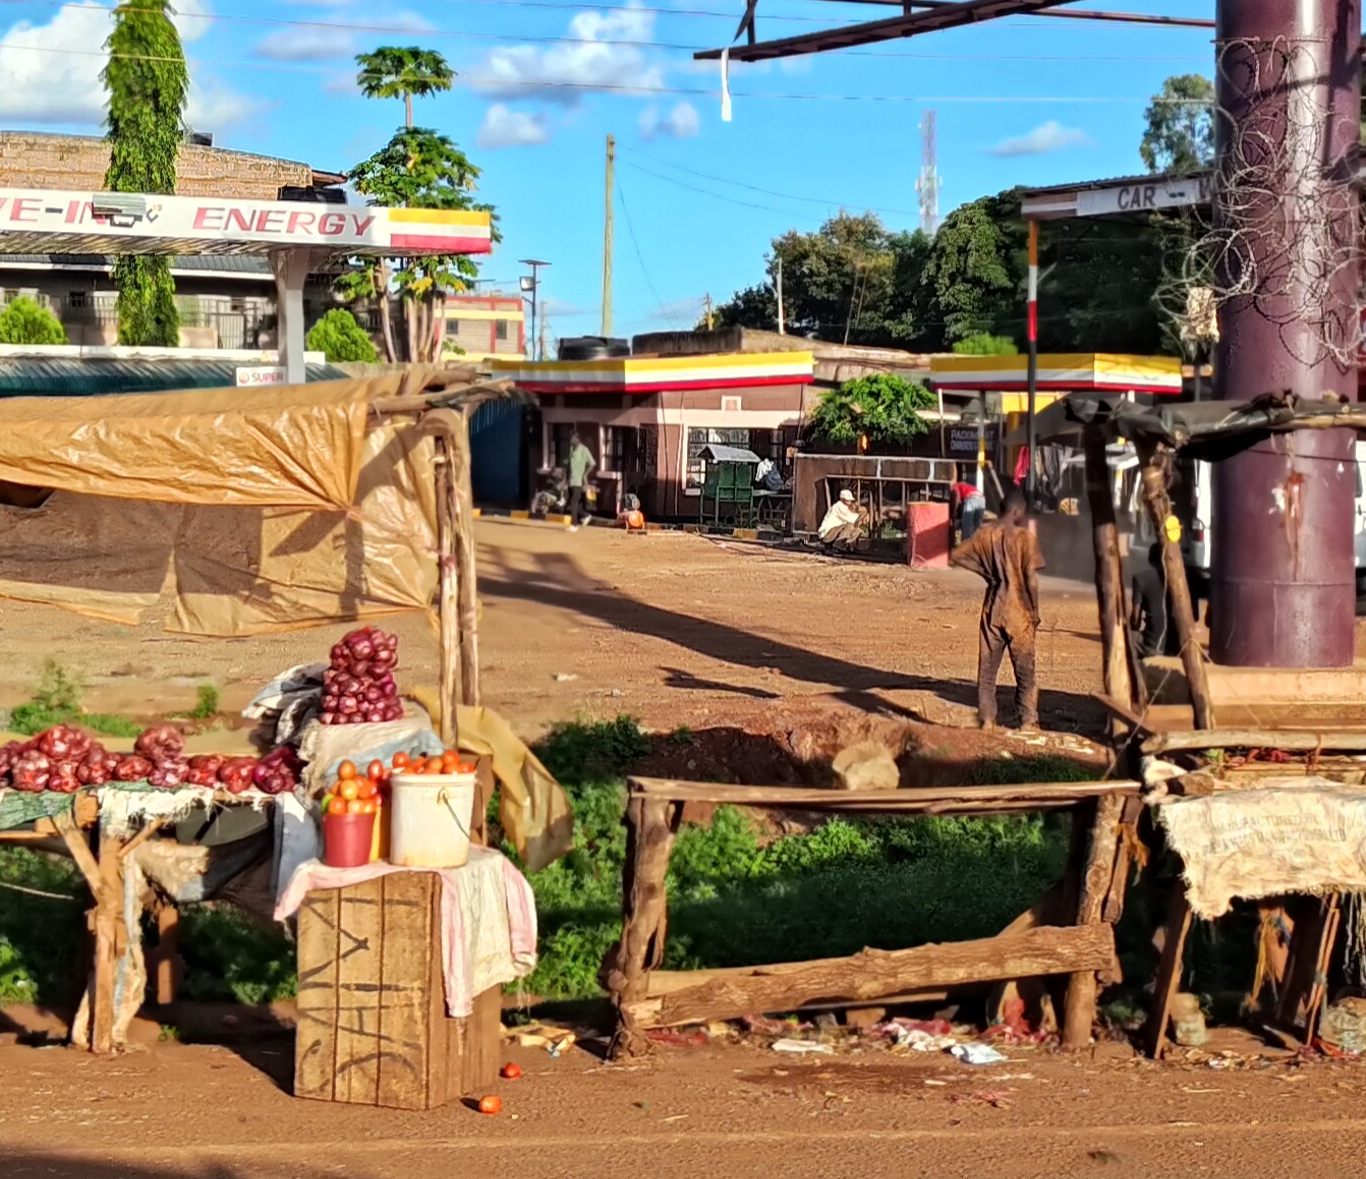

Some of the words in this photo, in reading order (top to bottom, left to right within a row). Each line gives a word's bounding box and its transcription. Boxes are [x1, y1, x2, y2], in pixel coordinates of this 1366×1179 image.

[1117, 186, 1156, 210] CAR
[192, 206, 375, 236] ENERGY
[252, 372, 284, 382] SUPER
